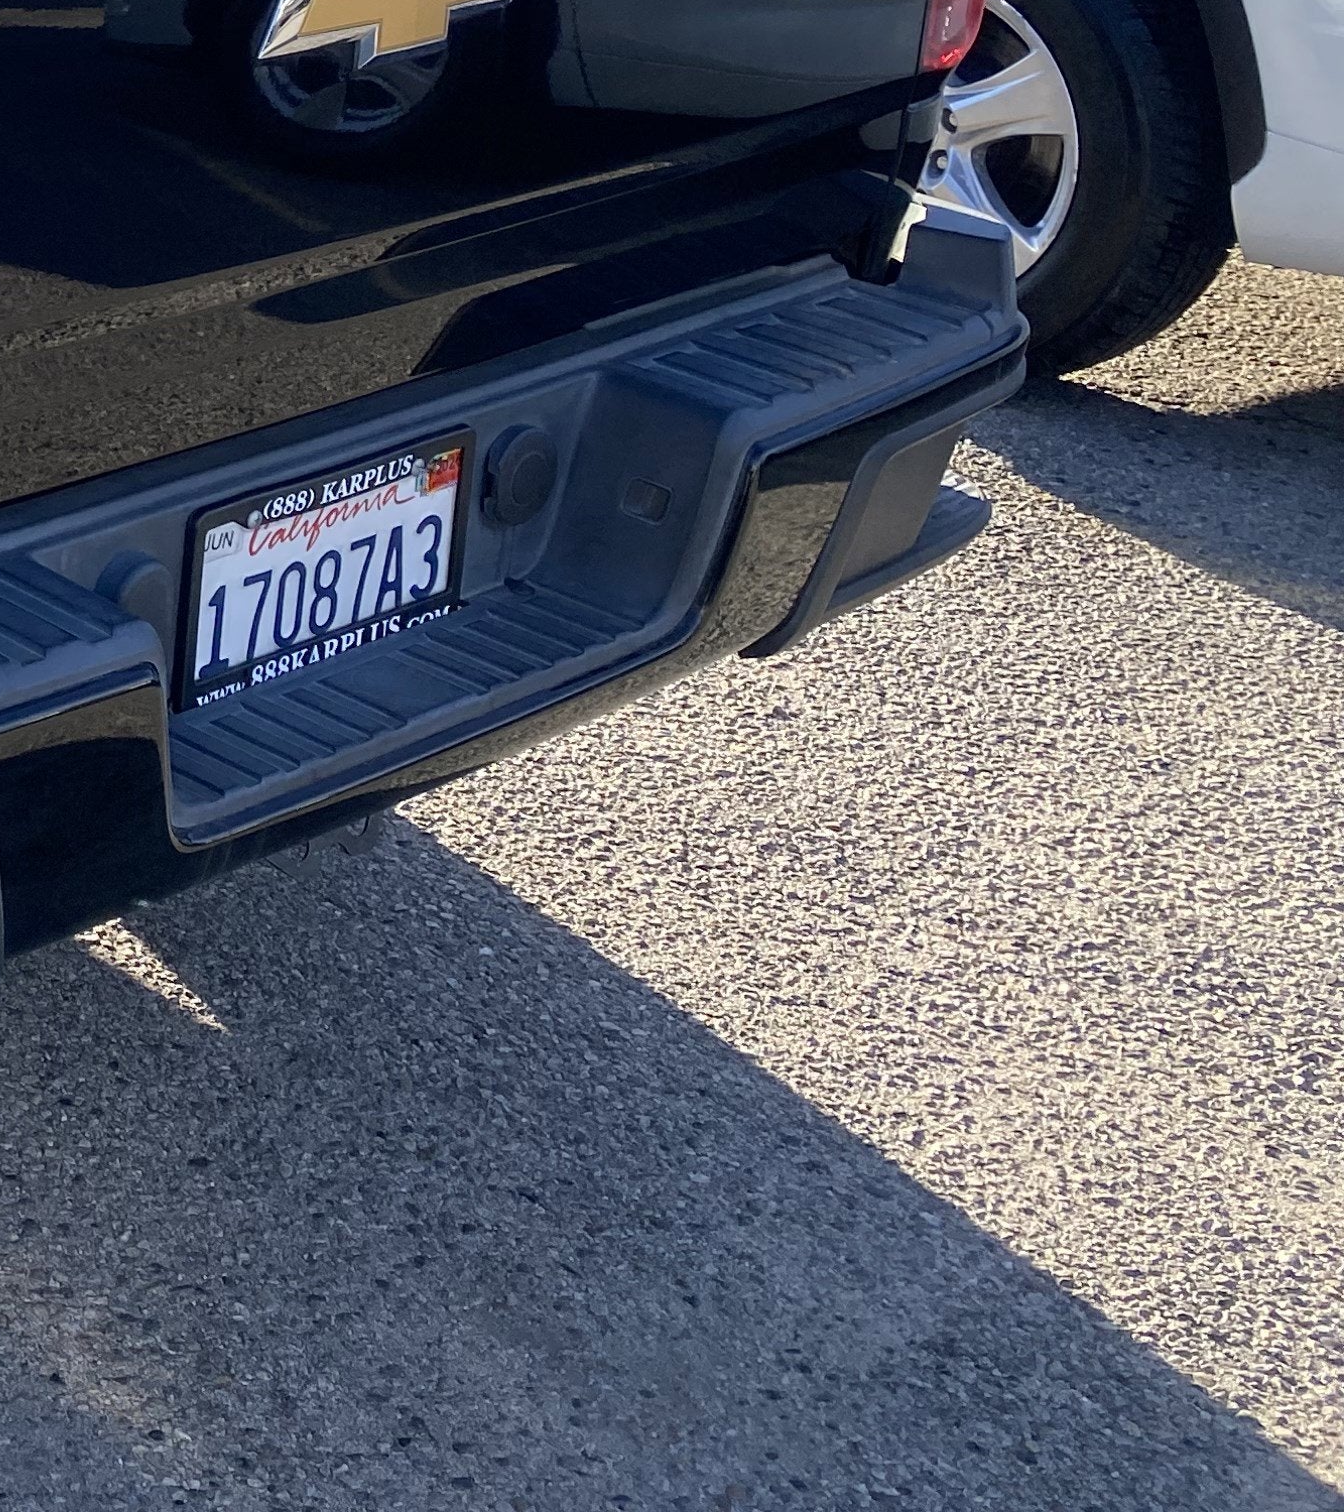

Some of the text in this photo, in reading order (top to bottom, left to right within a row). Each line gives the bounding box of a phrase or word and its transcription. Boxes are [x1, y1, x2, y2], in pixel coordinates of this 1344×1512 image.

[248, 483, 416, 556] California
[263, 454, 414, 520] (888) KARPLUS
[204, 530, 234, 553] JUN
[198, 514, 443, 680] 17087A3
